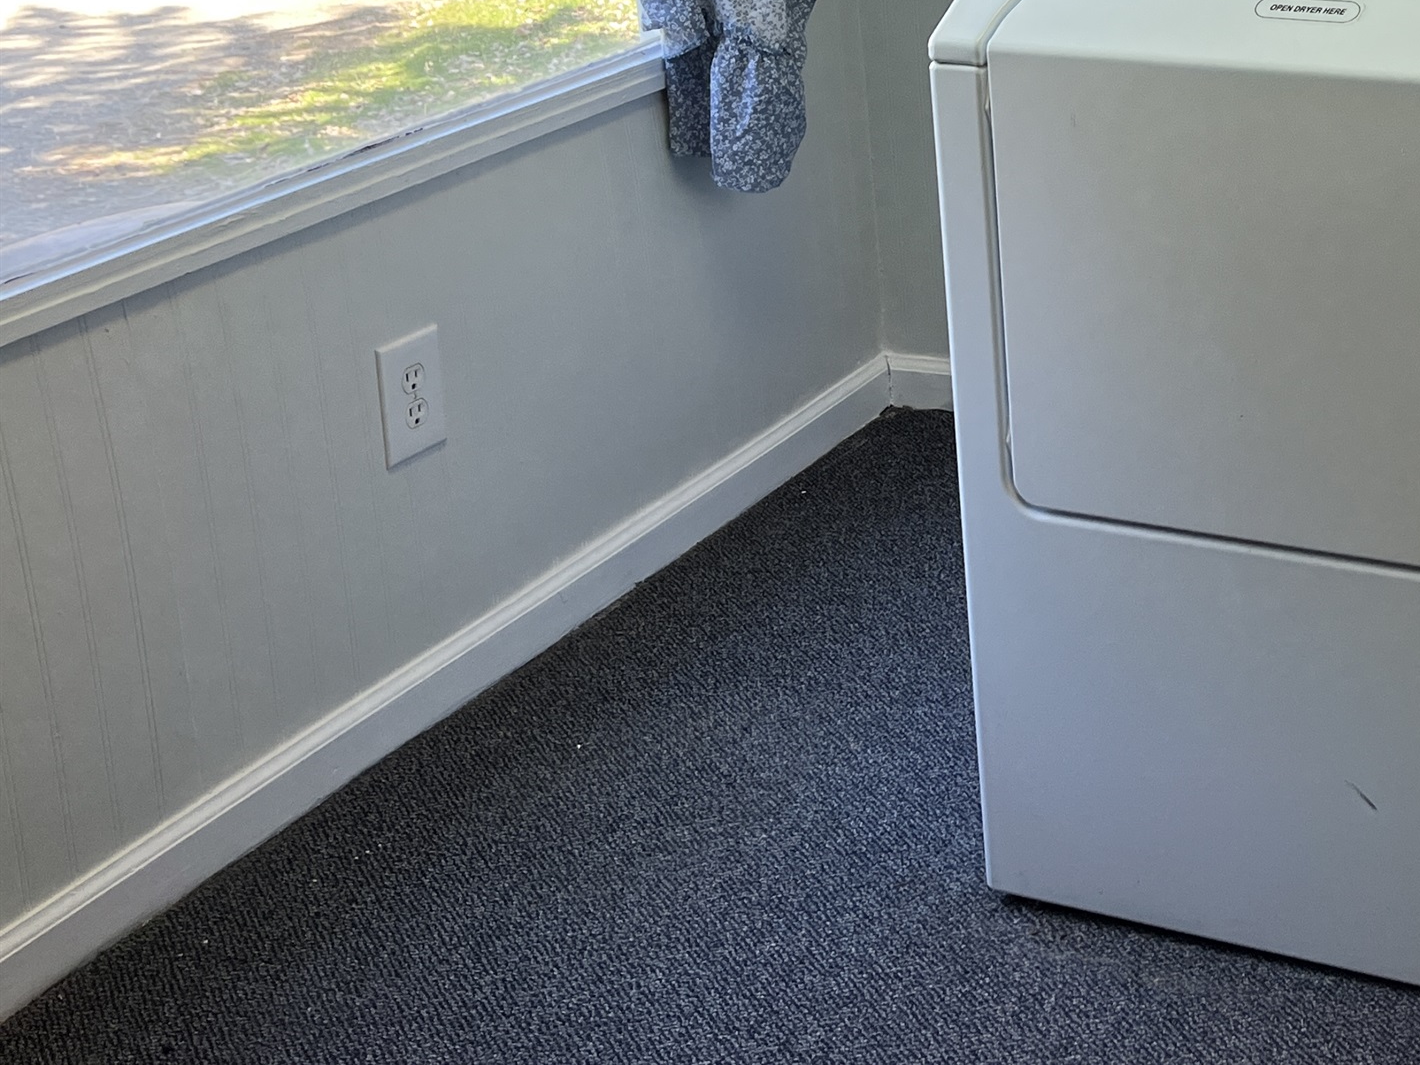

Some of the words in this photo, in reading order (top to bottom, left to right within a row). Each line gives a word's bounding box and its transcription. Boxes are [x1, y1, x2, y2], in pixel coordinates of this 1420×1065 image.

[1269, 4, 1294, 12] OPEN
[1293, 5, 1322, 14] DRYER
[1322, 7, 1347, 15] HERE
